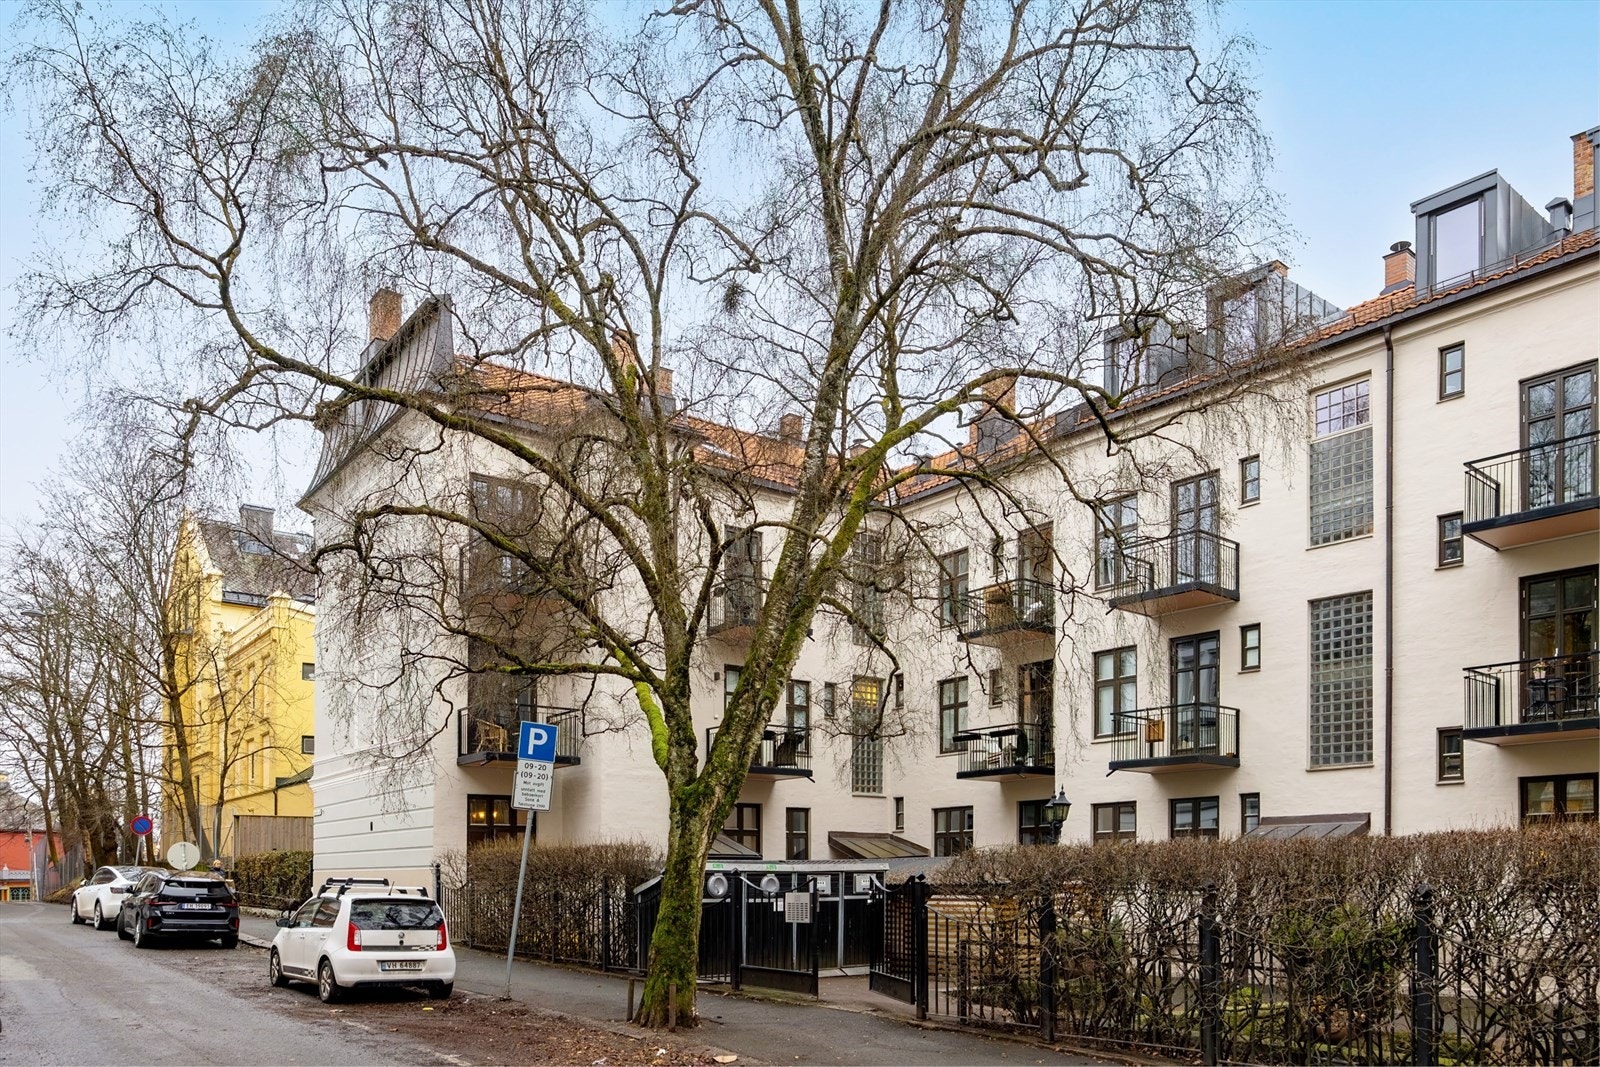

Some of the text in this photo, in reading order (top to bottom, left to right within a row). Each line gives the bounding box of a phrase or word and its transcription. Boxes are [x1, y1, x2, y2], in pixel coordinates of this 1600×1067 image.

[528, 728, 548, 755] P
[524, 762, 547, 770] 09-20
[520, 771, 548, 780] (09-20)
